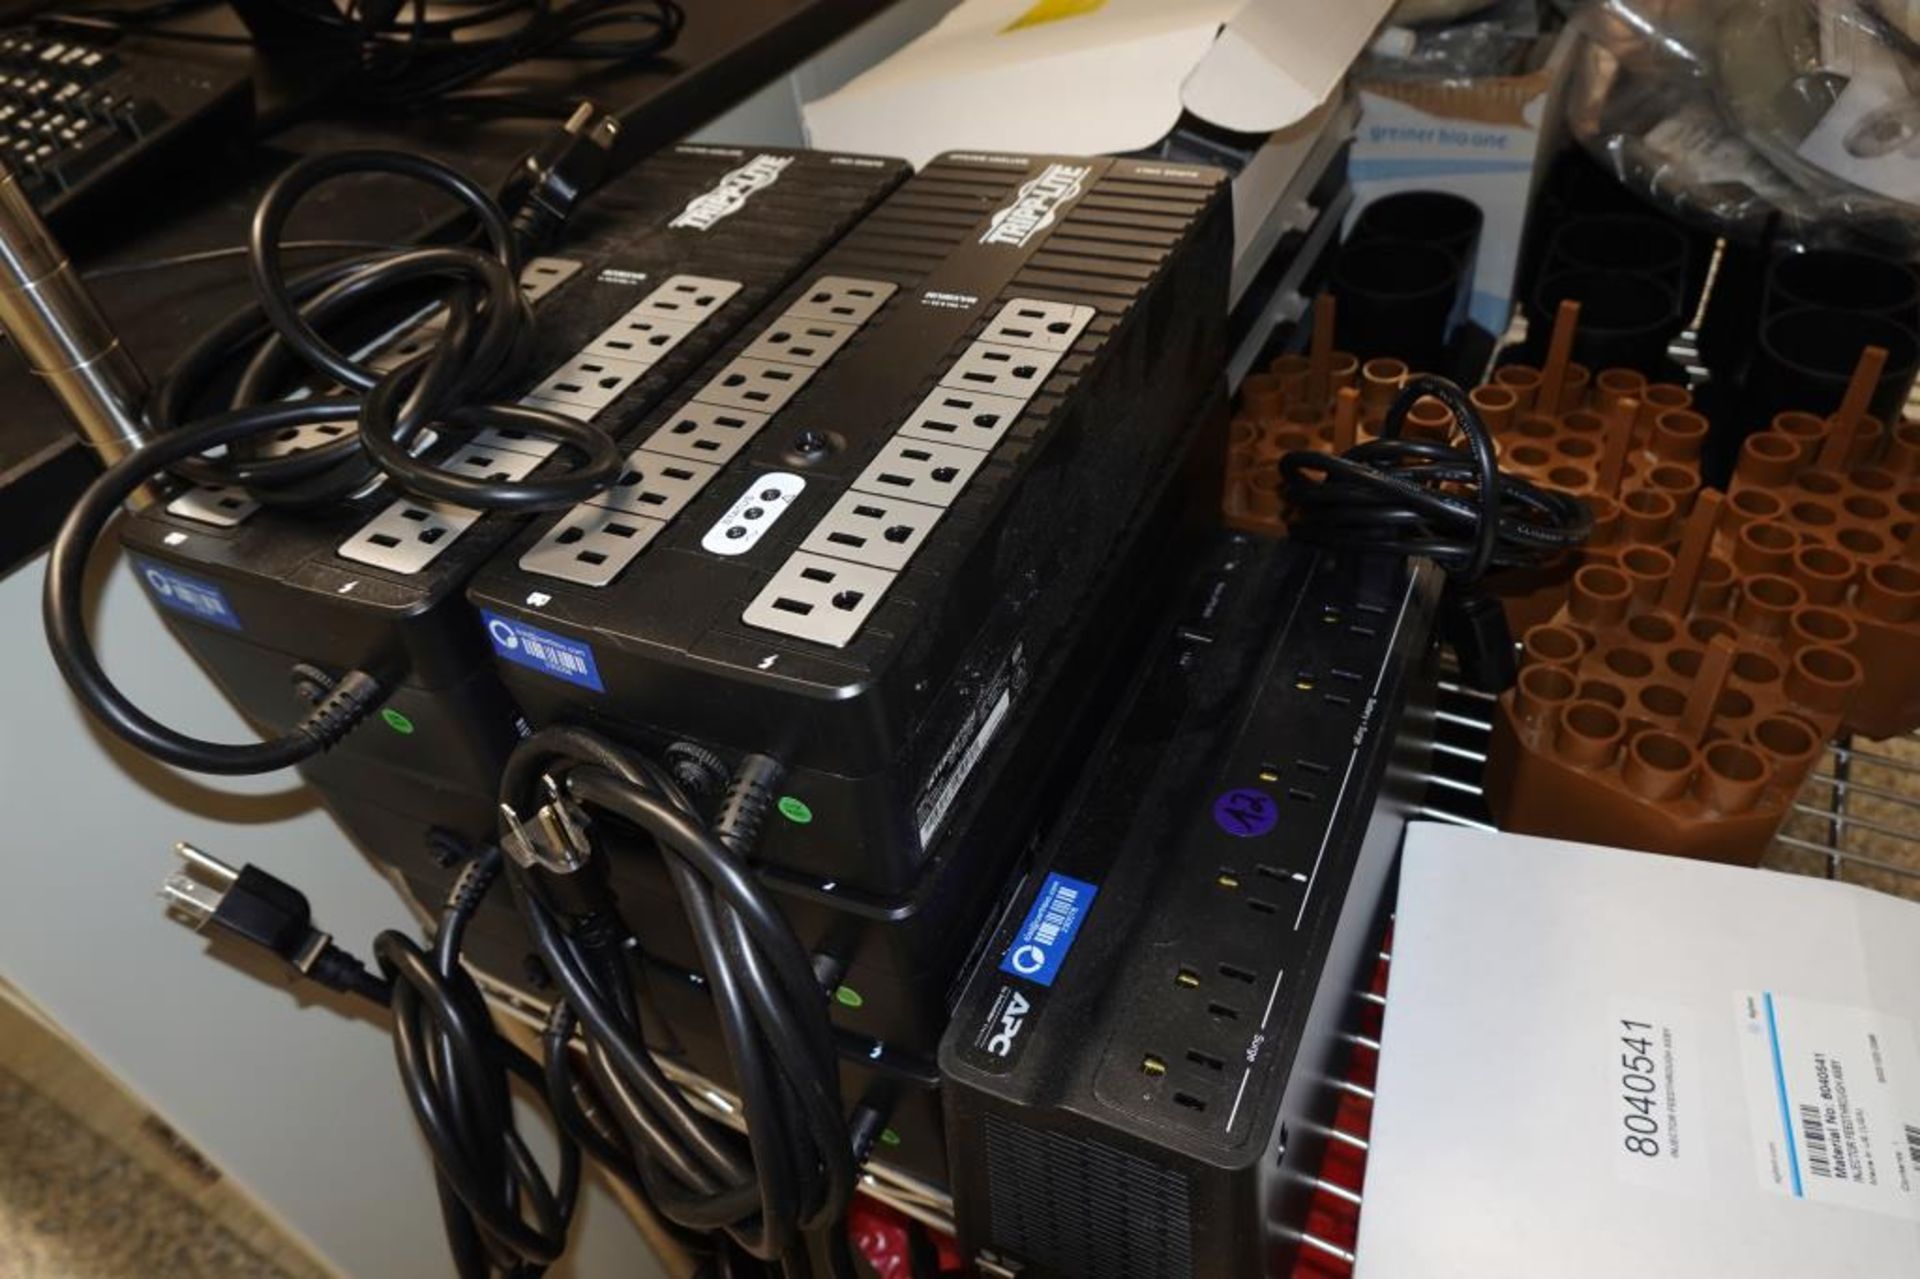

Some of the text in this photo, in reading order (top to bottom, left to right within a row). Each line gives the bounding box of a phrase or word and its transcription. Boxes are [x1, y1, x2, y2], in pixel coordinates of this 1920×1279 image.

[987, 991, 1031, 1057] APC
[1246, 1034, 1265, 1063] Surge
[1620, 1018, 1660, 1158] 8040541
[1814, 1052, 1833, 1101] 8040541
[1828, 1127, 1849, 1180] Material
